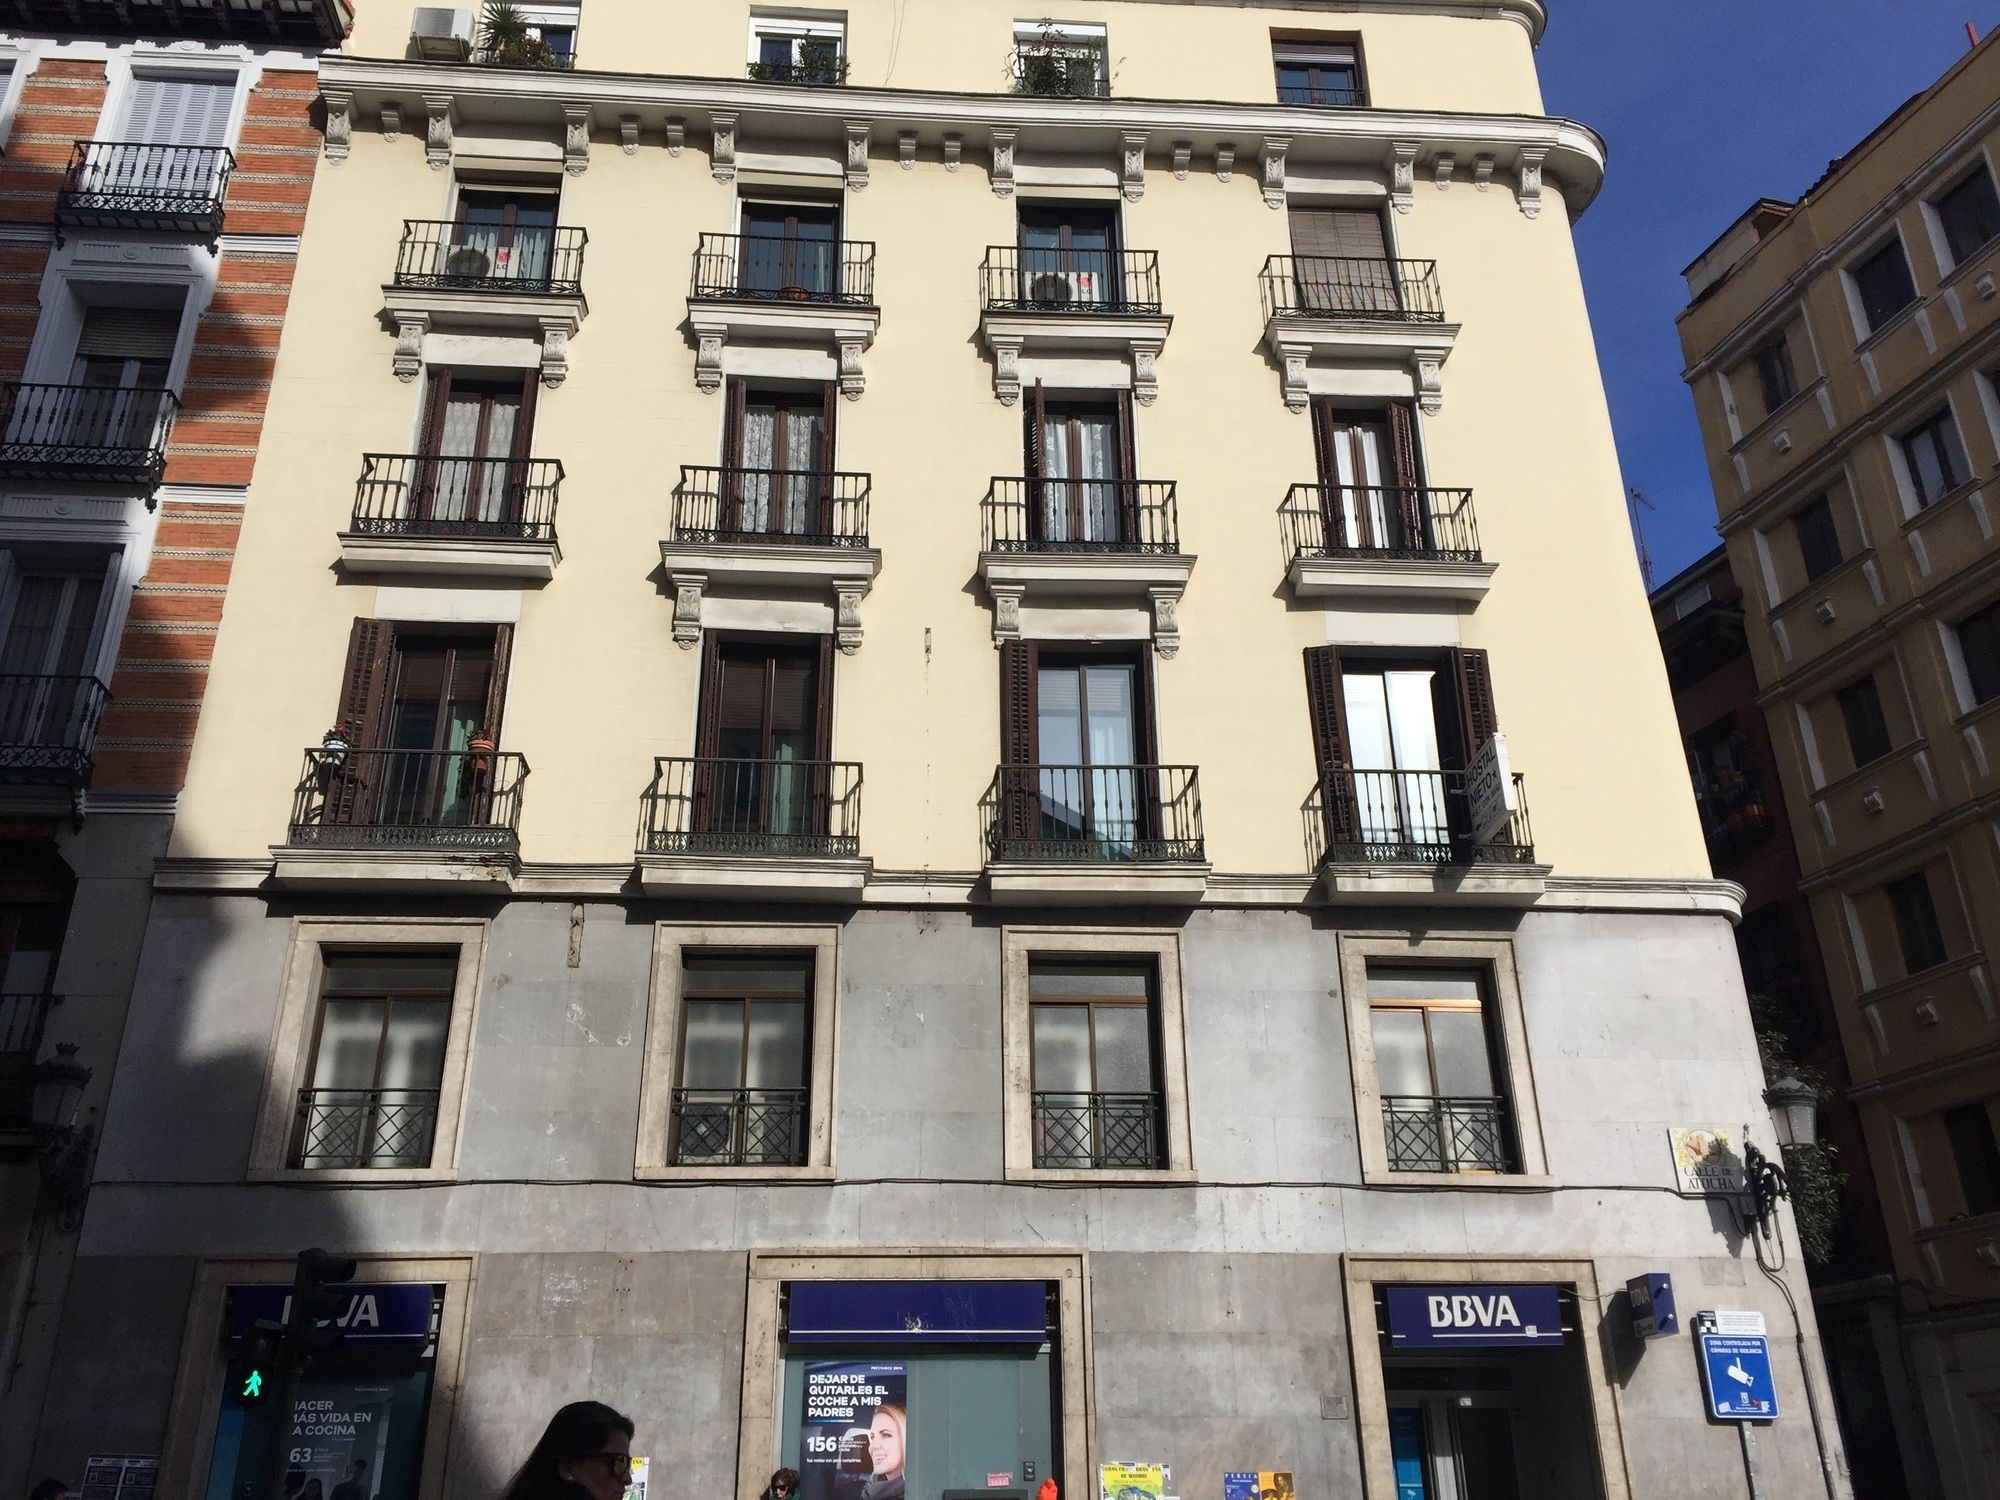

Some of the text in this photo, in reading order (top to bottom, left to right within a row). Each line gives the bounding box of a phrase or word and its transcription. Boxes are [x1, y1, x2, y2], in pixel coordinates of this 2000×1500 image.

[1467, 746, 1496, 788] HOSTAL
[1470, 772, 1492, 808] NIETO
[1684, 1167, 1734, 1177] CALLE DE
[1688, 1178, 1737, 1190] ATOCHA
[1427, 1295, 1521, 1328] BBVA
[809, 1374, 866, 1384] DEJAR DE
[808, 1385, 889, 1395] QUITARLES EL
[808, 1396, 882, 1406] COCHE A MIS
[319, 1412, 351, 1423] VIDA
[353, 1412, 372, 1423] EN
[807, 1407, 854, 1418] PADRES
[291, 1425, 357, 1436] A COCINA
[806, 1435, 837, 1453] 156
[289, 1447, 312, 1463] 63
